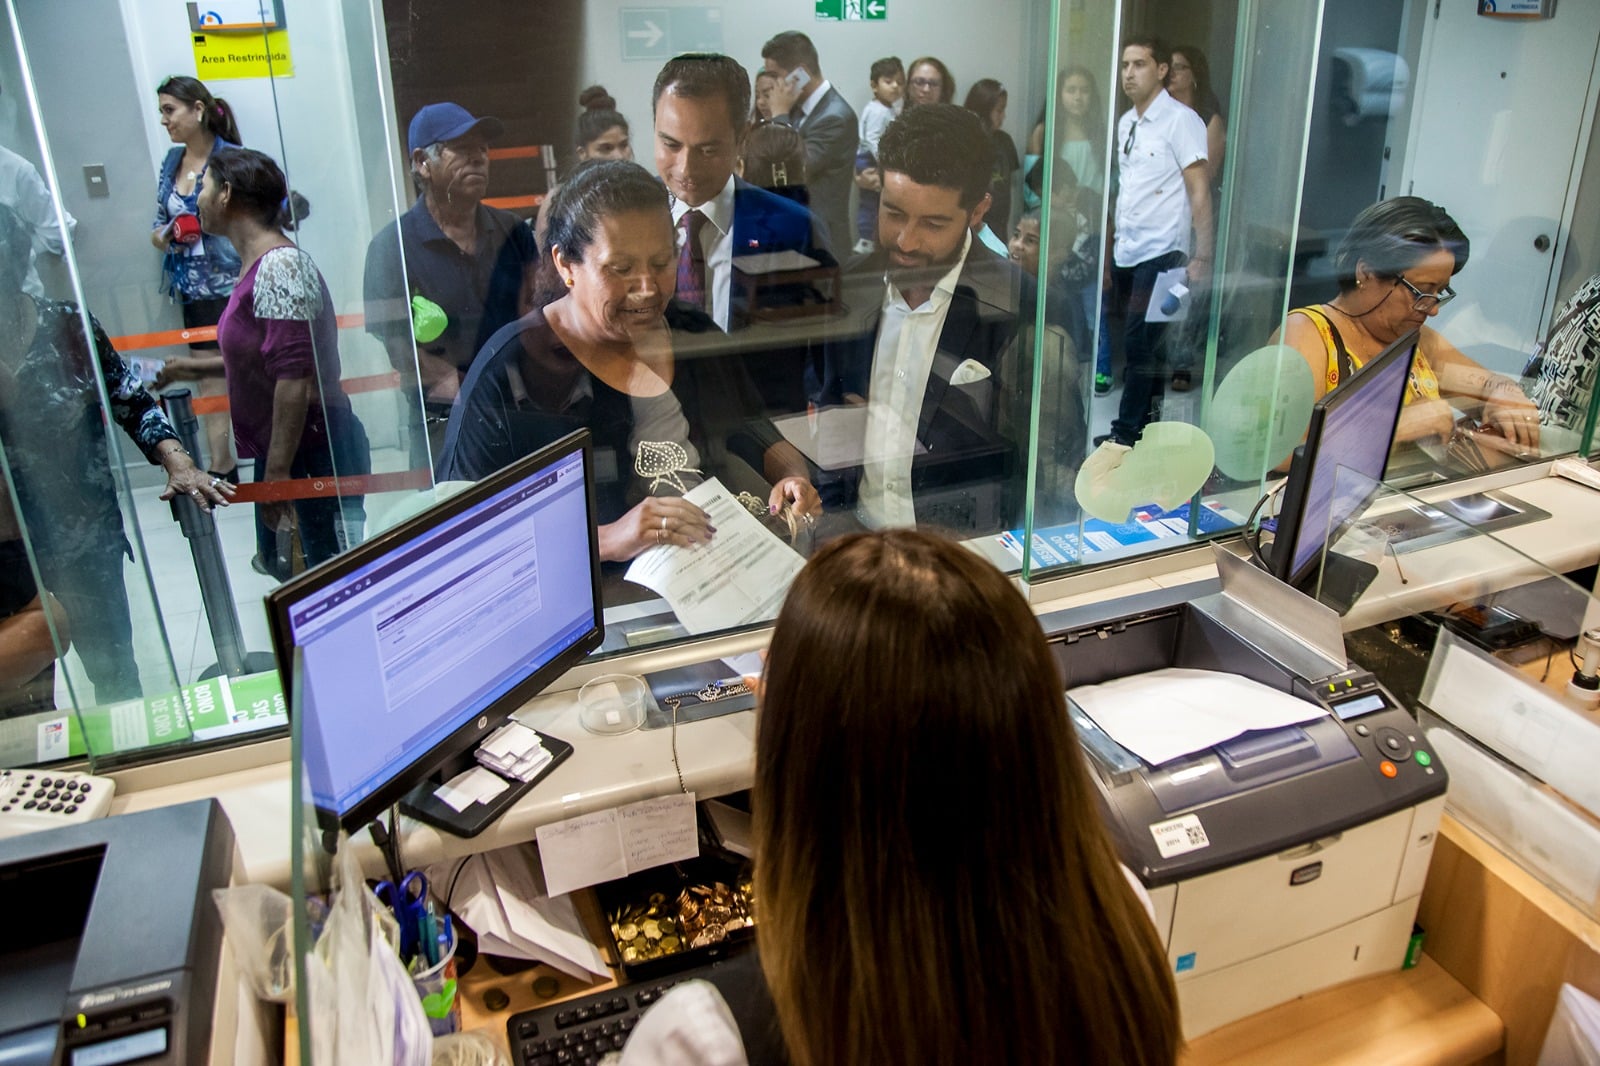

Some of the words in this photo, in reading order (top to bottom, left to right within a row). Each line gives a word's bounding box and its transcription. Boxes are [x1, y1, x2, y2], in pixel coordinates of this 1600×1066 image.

[202, 55, 225, 64] Area
[228, 52, 287, 64] Restringida
[151, 698, 169, 715] DE
[194, 683, 215, 714] BONO
[153, 714, 172, 737] ORO
